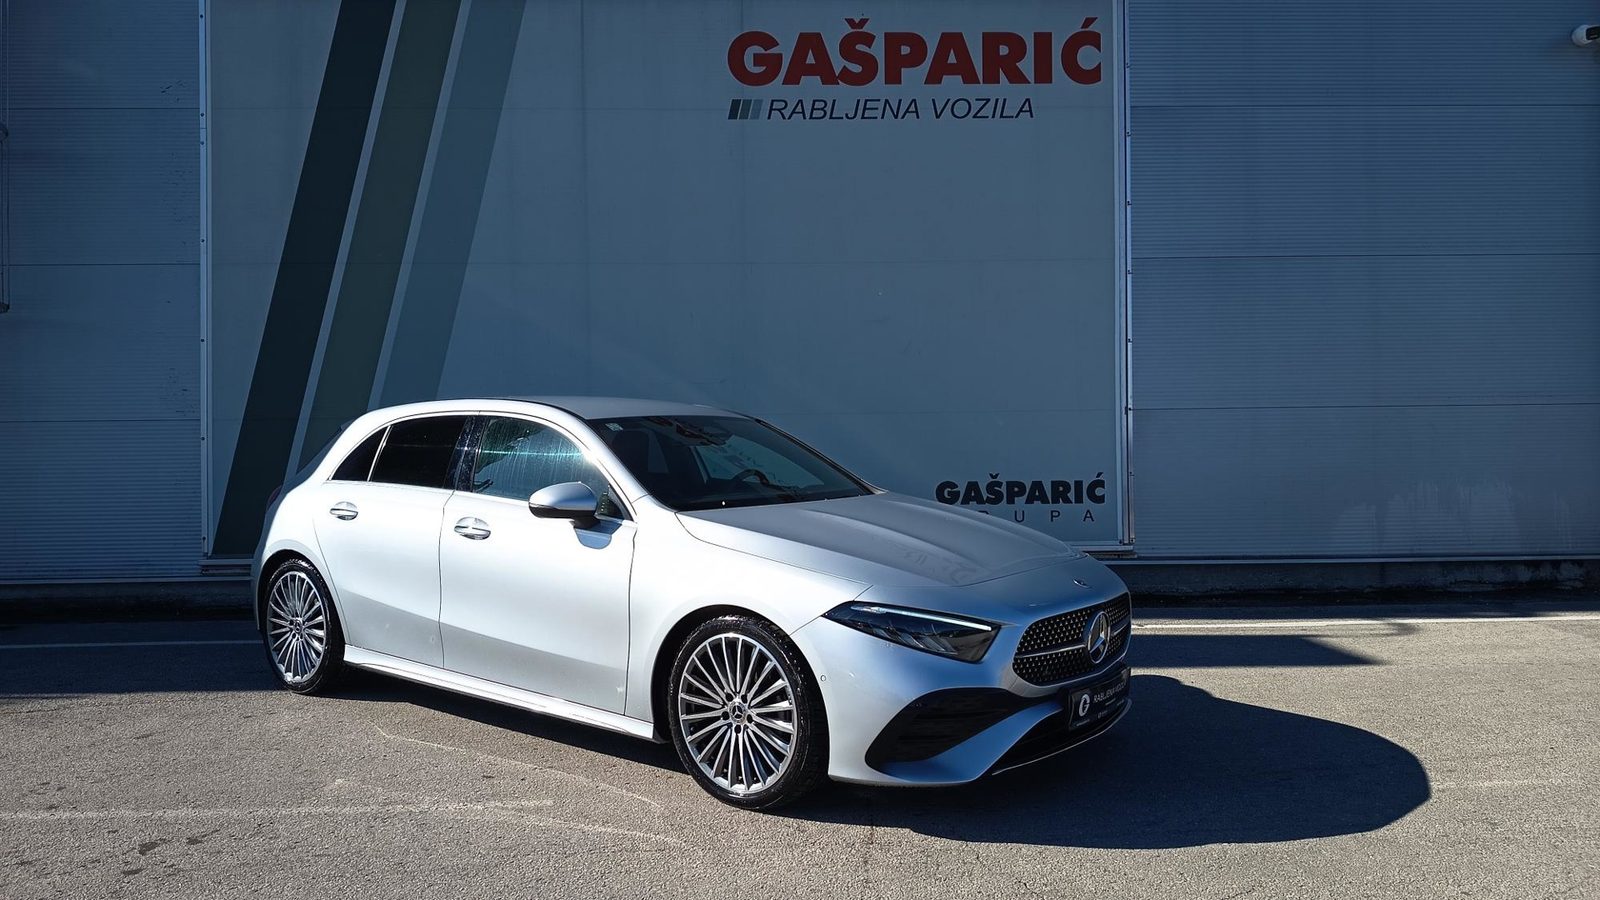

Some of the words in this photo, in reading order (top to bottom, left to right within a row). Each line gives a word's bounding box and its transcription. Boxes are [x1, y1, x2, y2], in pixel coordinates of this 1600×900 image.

[727, 17, 1102, 86] GAŠPARIĆ
[767, 98, 921, 120] RABLJENA
[931, 98, 1034, 120] VOZILA
[935, 472, 1106, 505] GAŠPARIĆ
